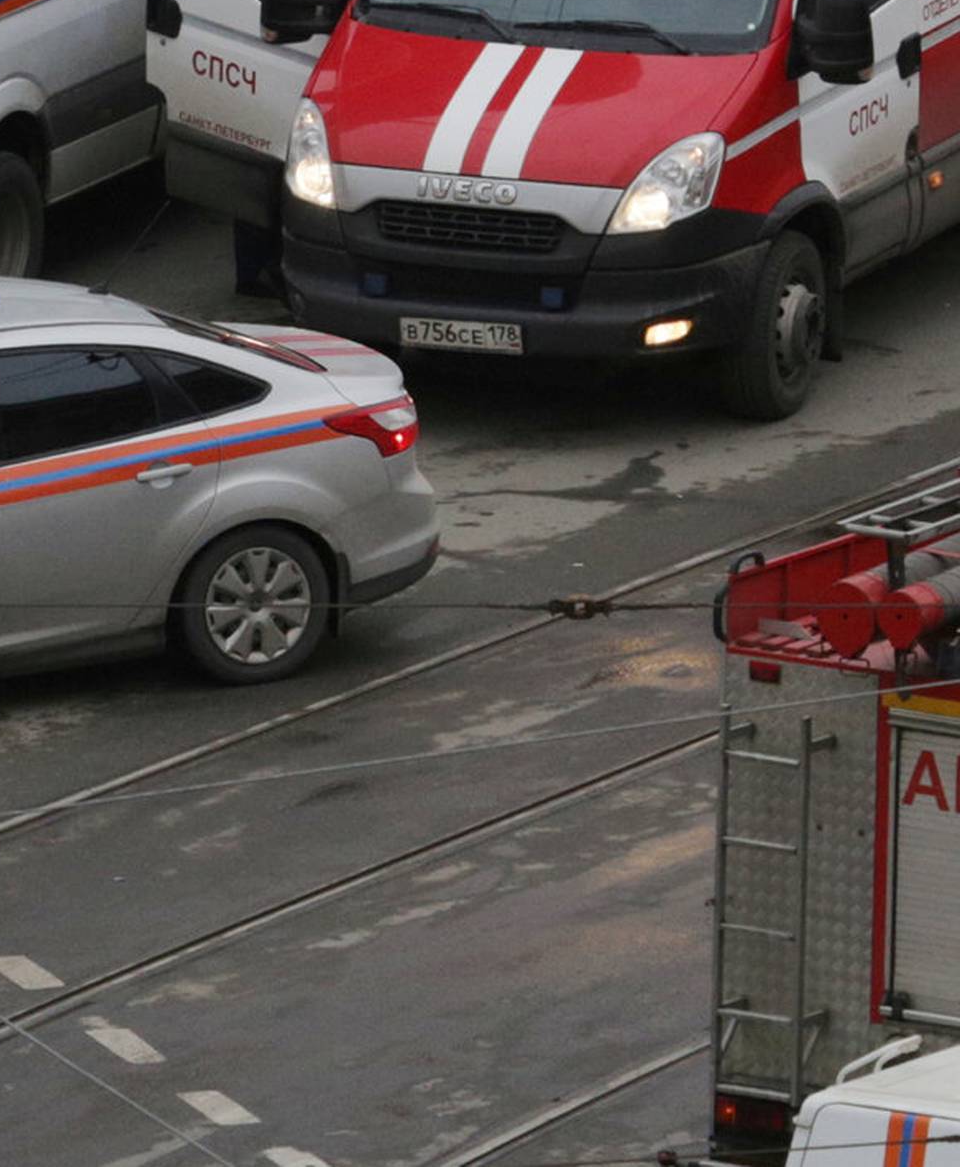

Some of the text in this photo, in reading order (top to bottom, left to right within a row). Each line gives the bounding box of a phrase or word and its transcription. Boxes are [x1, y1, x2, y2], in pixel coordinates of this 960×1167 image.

[191, 49, 257, 95] СПСЧ
[178, 110, 273, 151] САНКТ-ПЕТЕРБУРГ
[848, 94, 889, 136] СПСЧ
[417, 175, 518, 205] IVECO
[487, 325, 519, 342] 178
